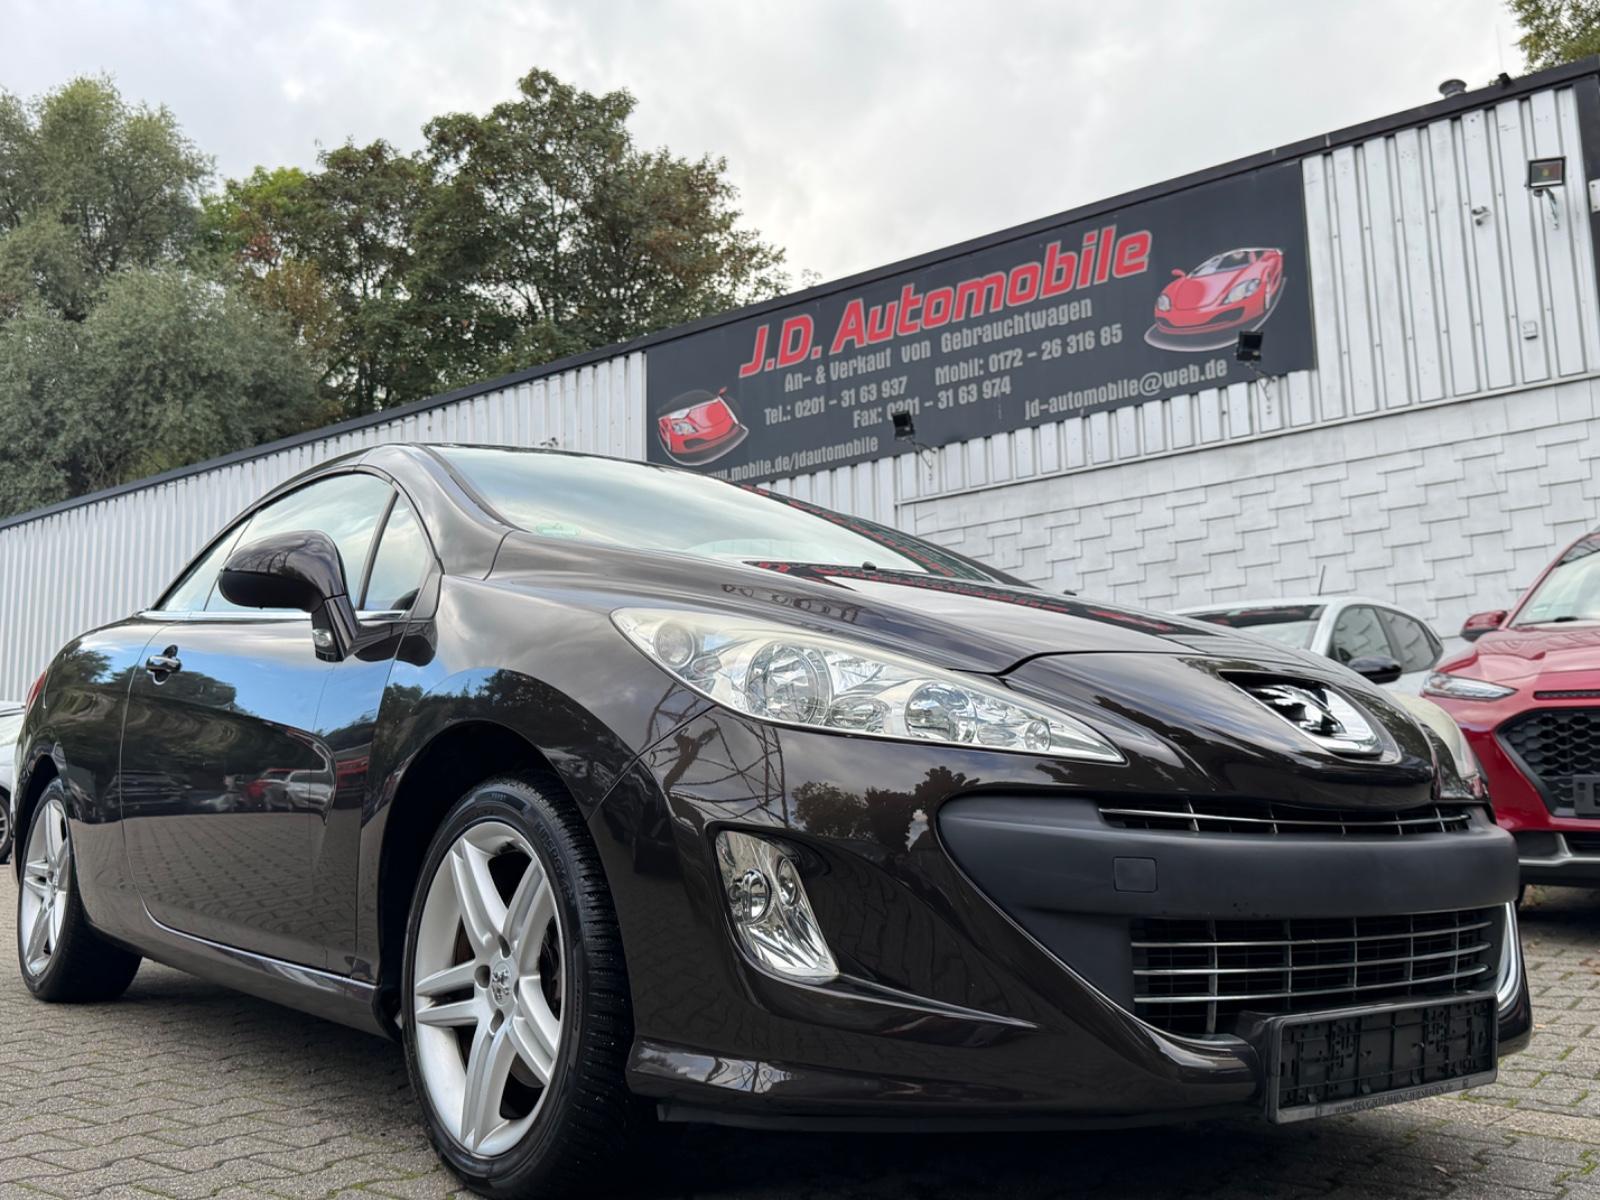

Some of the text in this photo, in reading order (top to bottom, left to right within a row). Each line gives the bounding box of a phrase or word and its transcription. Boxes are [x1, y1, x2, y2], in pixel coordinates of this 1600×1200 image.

[739, 224, 1152, 378] J.D. Automobile
[784, 298, 1092, 392] An- & Verkauf von Gebrauchtwagen
[764, 404, 791, 425] Tel.:
[795, 397, 825, 418] 0201
[841, 387, 857, 408] 31
[859, 382, 878, 403] 63
[881, 376, 908, 397] 937
[935, 357, 984, 386] Mobil:
[988, 347, 1023, 373] 0172
[1041, 337, 1062, 361] 26
[1066, 330, 1095, 355] 316
[1100, 323, 1123, 347] 85
[853, 406, 883, 428] Fax:
[937, 386, 954, 411] 31
[958, 382, 978, 405] 63
[982, 376, 1011, 399] 974
[1024, 358, 1229, 421] jd-automobile@web.de
